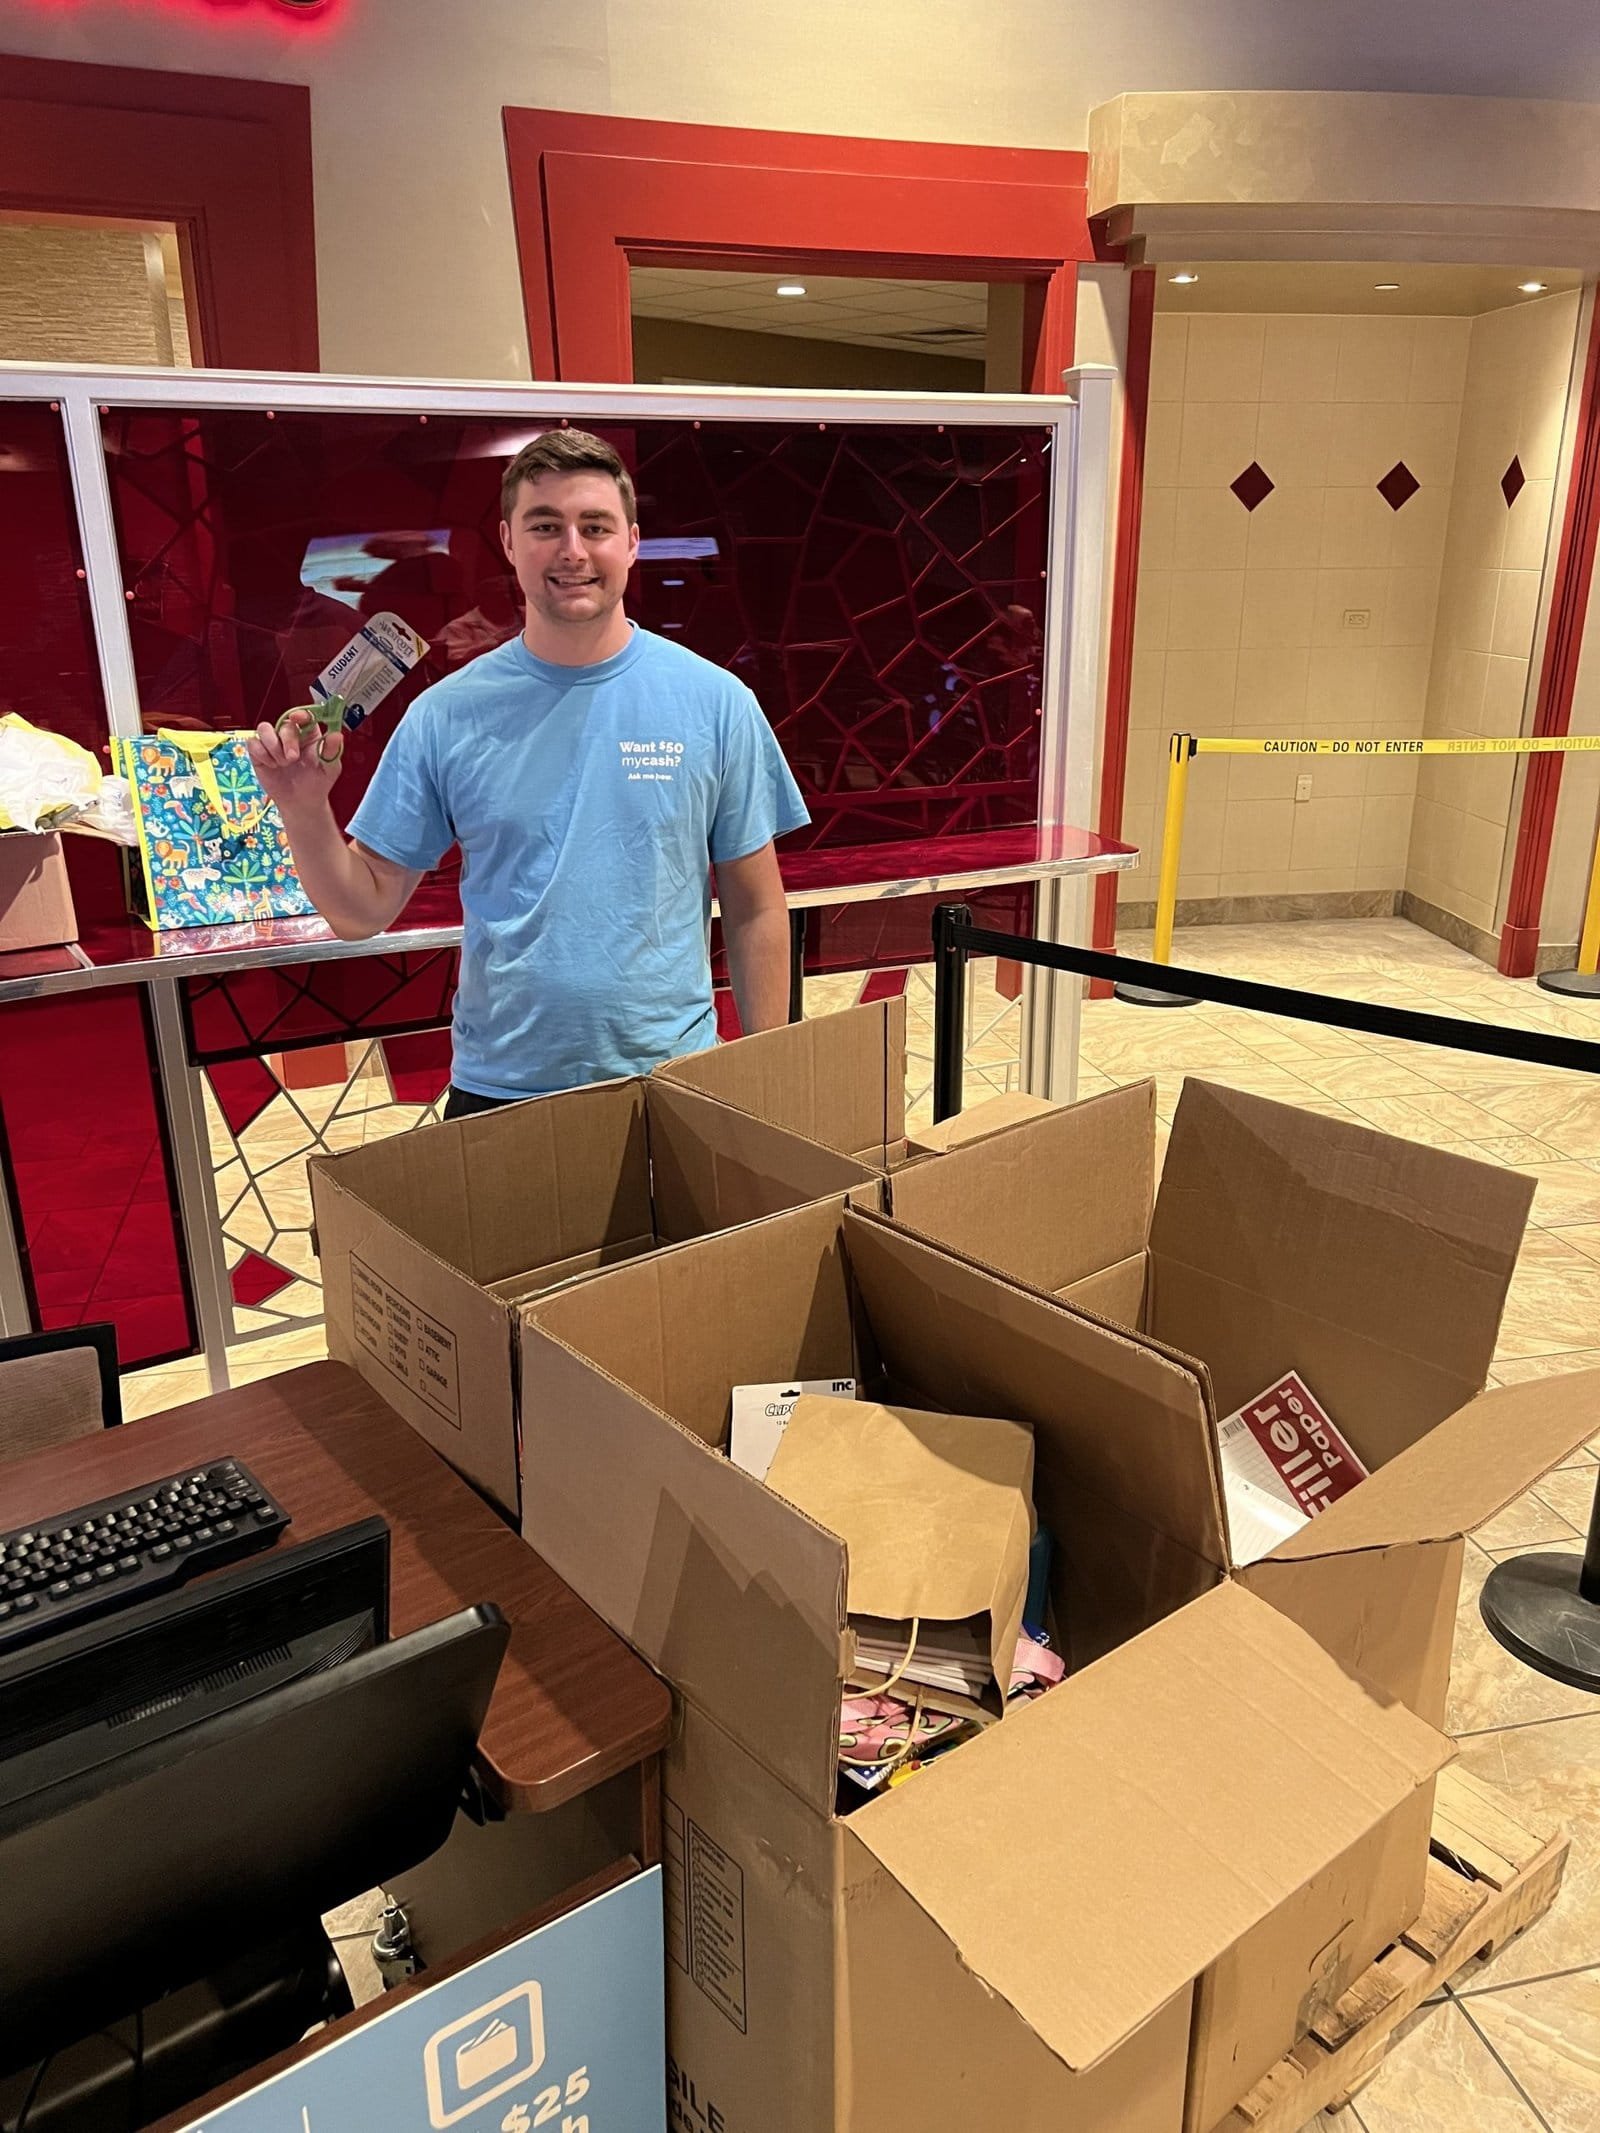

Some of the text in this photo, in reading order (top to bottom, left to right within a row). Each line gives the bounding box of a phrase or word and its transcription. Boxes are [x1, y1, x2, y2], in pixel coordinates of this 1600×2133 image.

[328, 645, 359, 680] STUDENT
[619, 740, 684, 754] Want $50
[1264, 741, 1317, 752] CAUTION
[1332, 741, 1349, 752] DO
[1355, 741, 1380, 752] NOT
[1386, 741, 1423, 752] ENTER
[622, 755, 682, 769] mycash?
[1278, 1388, 1343, 1469] paper
[501, 2065, 590, 2133] $25
